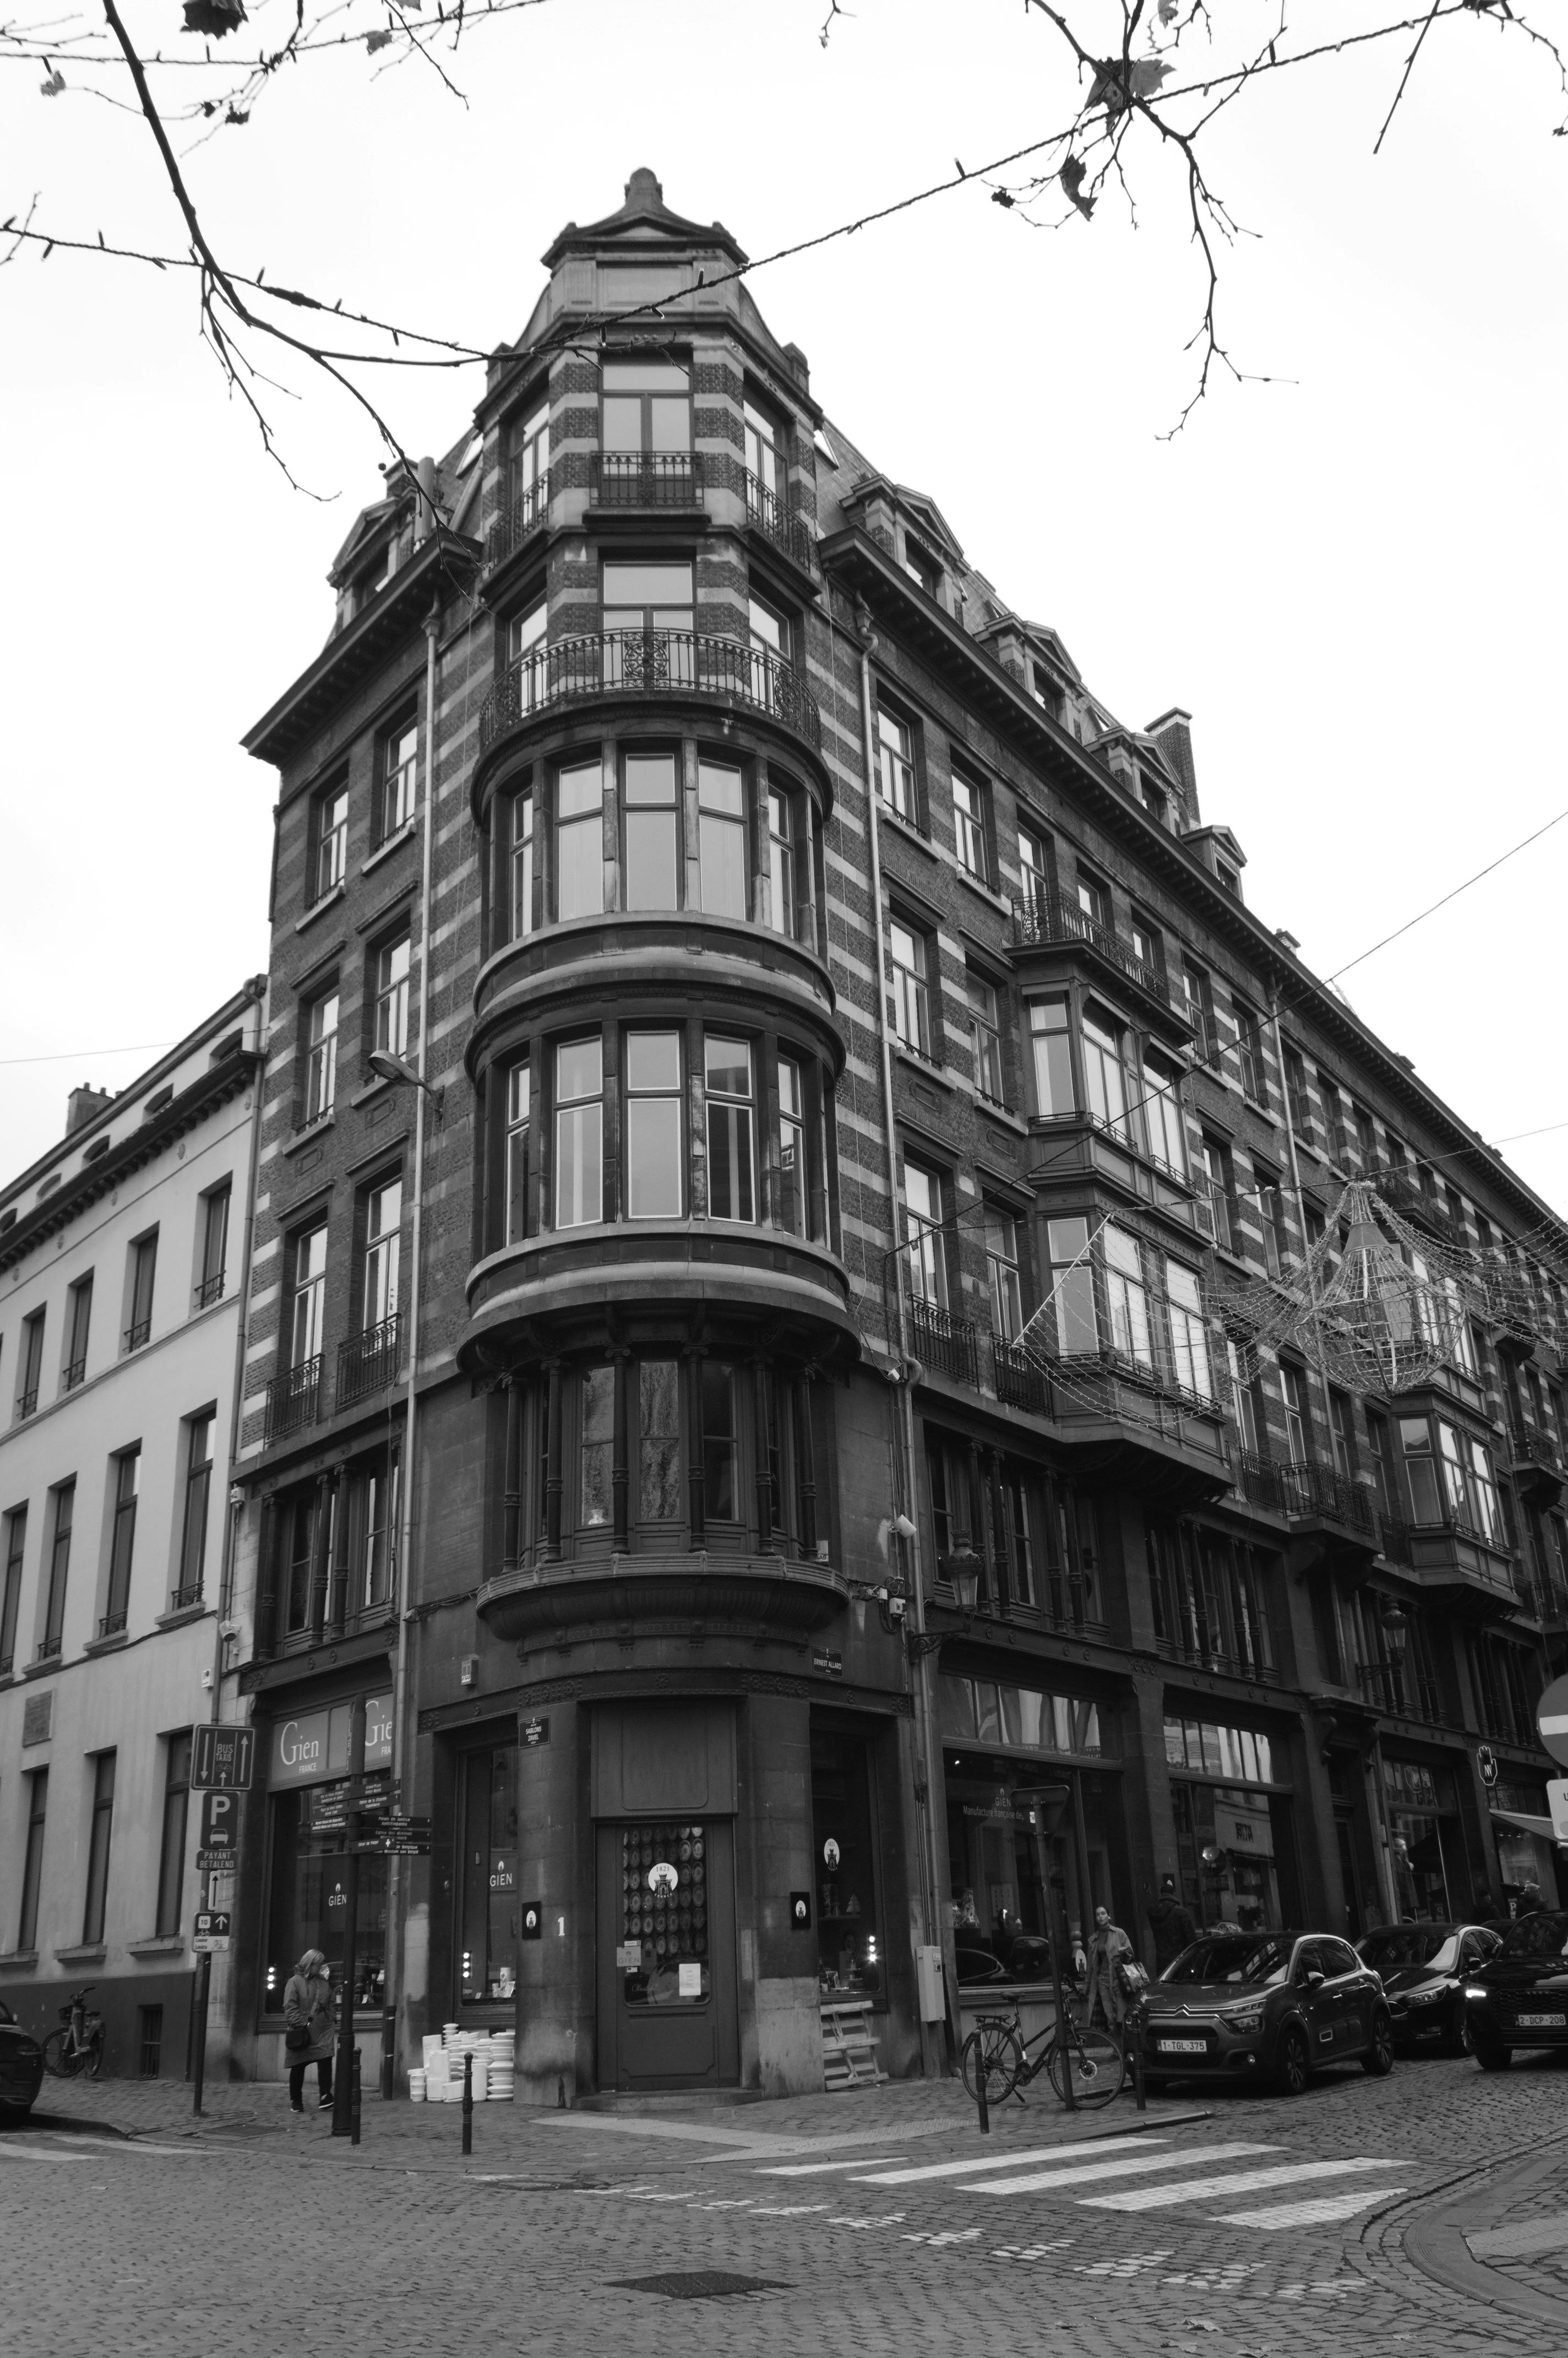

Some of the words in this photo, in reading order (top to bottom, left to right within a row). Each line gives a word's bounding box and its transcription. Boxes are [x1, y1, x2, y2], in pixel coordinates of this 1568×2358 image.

[814, 1658, 828, 1667] ERNEST
[828, 1661, 842, 1670] ALLARD
[364, 1700, 393, 1747] Gie
[216, 1743, 233, 1754] BUS
[280, 1721, 319, 1765] Gien
[216, 1753, 232, 1762] TAXIS
[299, 1763, 317, 1774] FRANCE
[995, 1796, 1012, 1807] GIEN
[210, 1796, 231, 1825] P
[963, 1806, 994, 1817] Manufacture
[204, 1851, 231, 1860] PAYANT
[199, 1860, 234, 1869] BETALEND
[489, 1873, 513, 1887] GIEN
[328, 1894, 347, 1906] GIEN
[557, 1916, 565, 1936] 1
